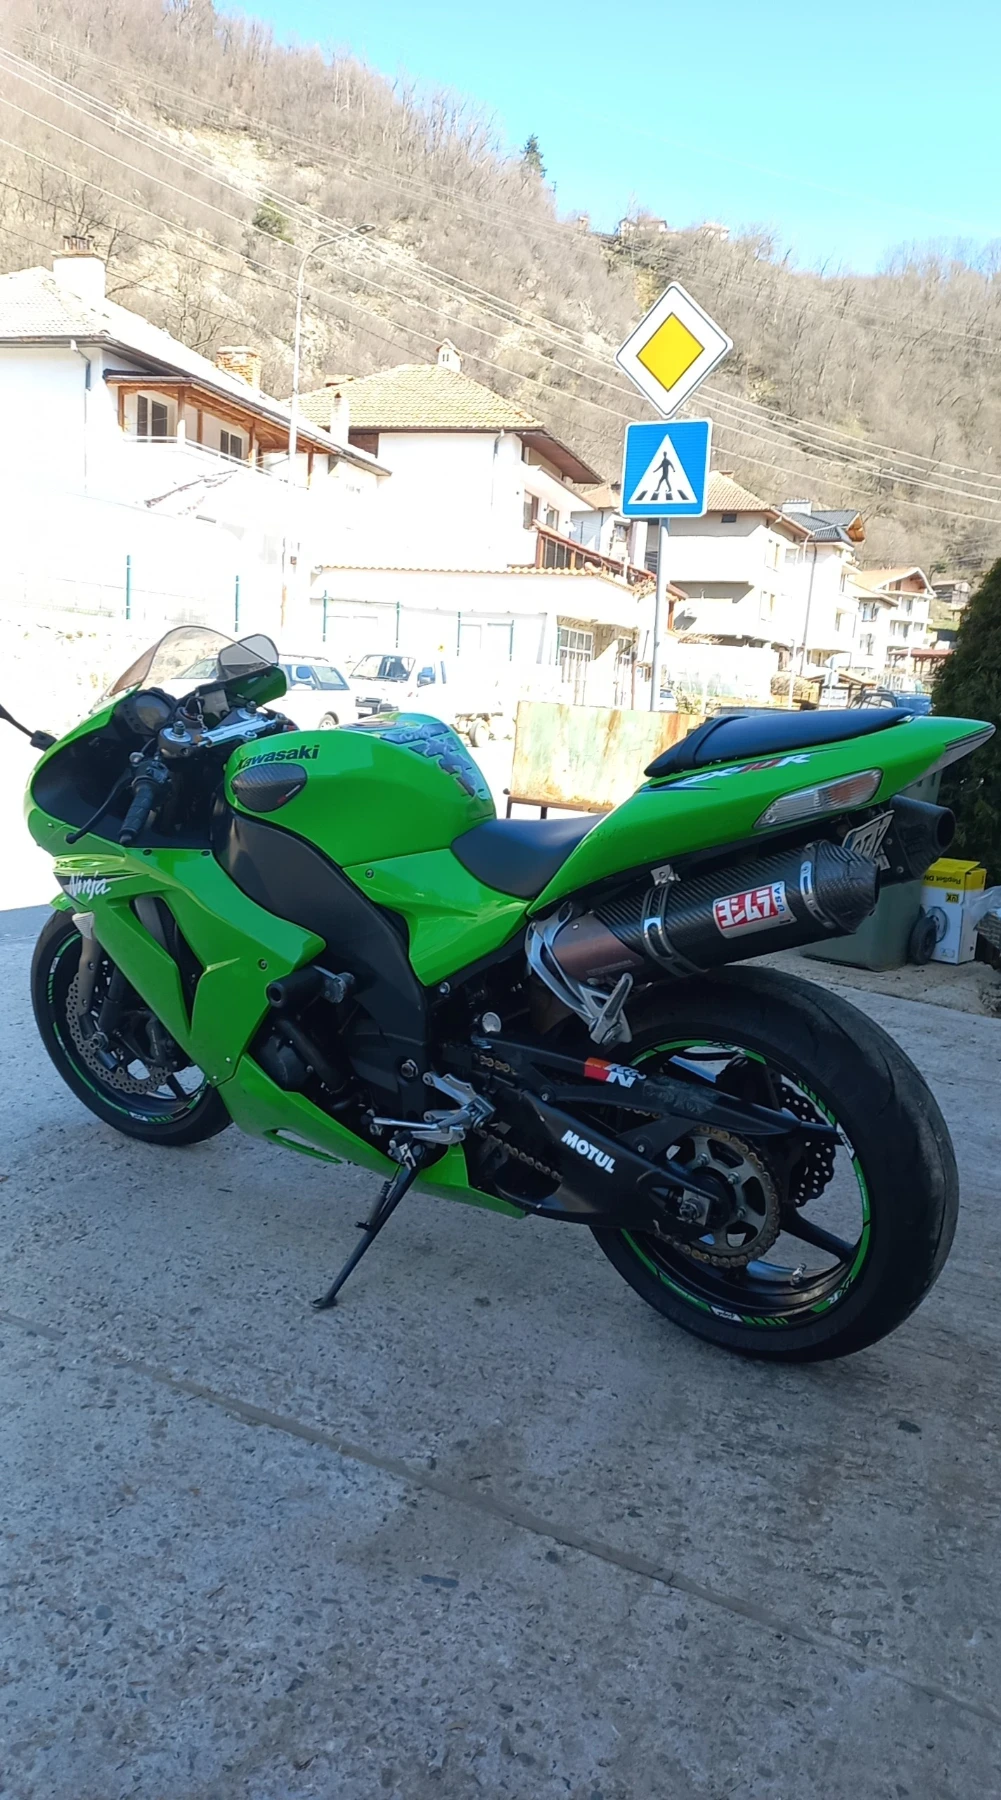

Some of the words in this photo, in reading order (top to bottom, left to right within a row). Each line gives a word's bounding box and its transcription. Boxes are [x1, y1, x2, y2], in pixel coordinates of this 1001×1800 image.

[237, 744, 320, 770] Kawasaki
[69, 870, 112, 902] Ninja
[774, 887, 786, 912] USA
[604, 1063, 647, 1089] K&N
[561, 1129, 616, 1174] MOTUL
